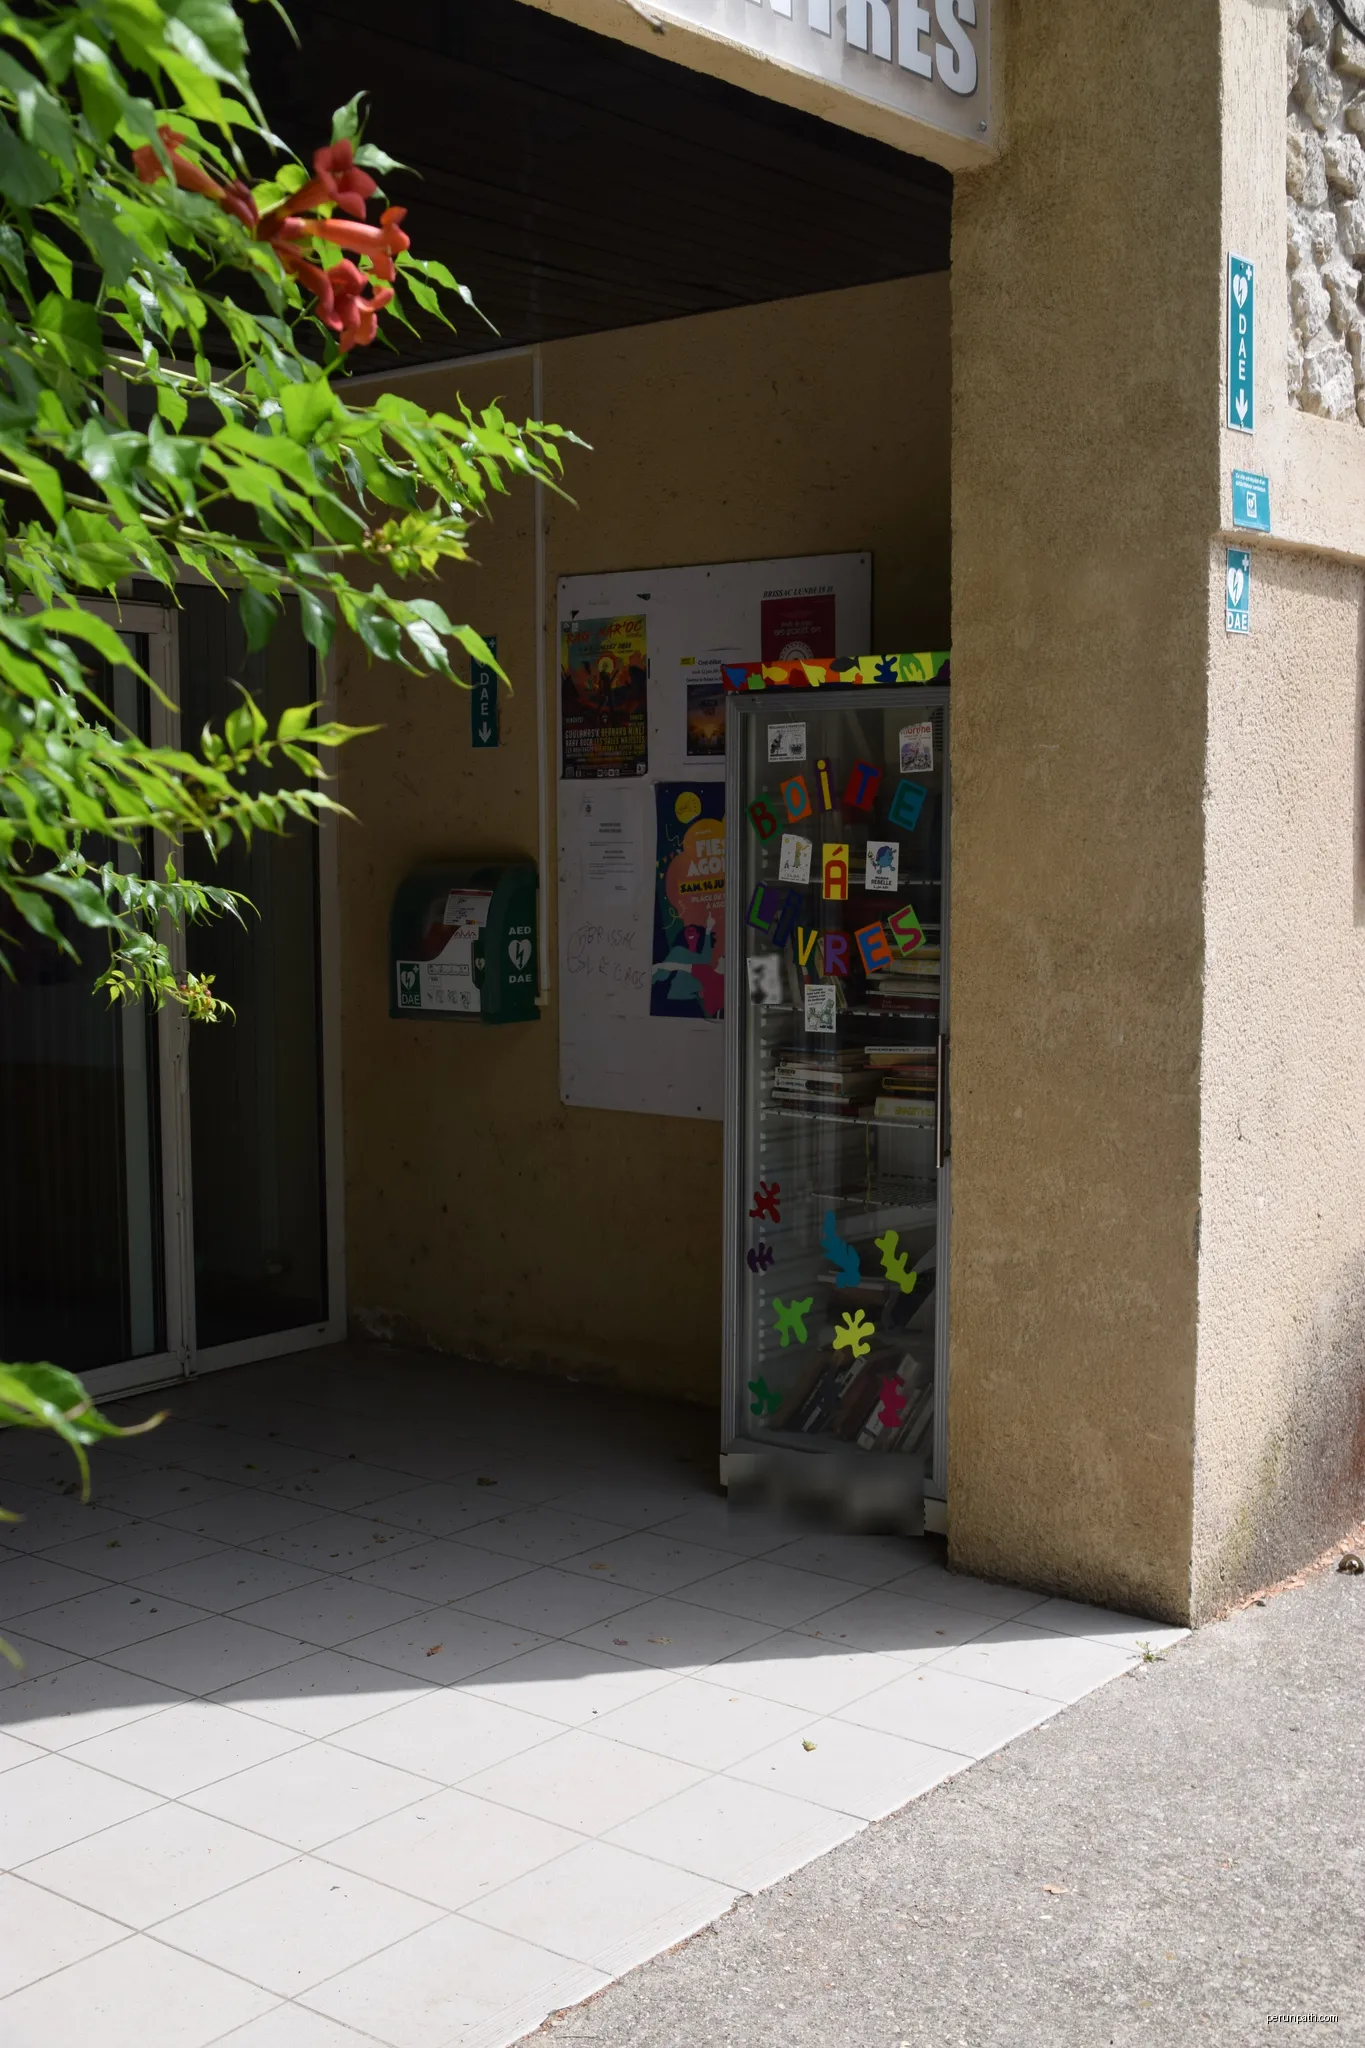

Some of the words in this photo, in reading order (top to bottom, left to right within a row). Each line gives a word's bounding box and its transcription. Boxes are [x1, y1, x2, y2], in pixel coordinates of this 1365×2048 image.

[1237, 314, 1247, 381] DAE
[763, 589, 793, 598] BRISSAC
[793, 587, 817, 596] LUNDI
[1228, 611, 1247, 630] DAE
[480, 672, 489, 715] DAE
[508, 926, 532, 936] AED
[508, 974, 533, 984] DAE
[401, 993, 421, 1005] DAE
